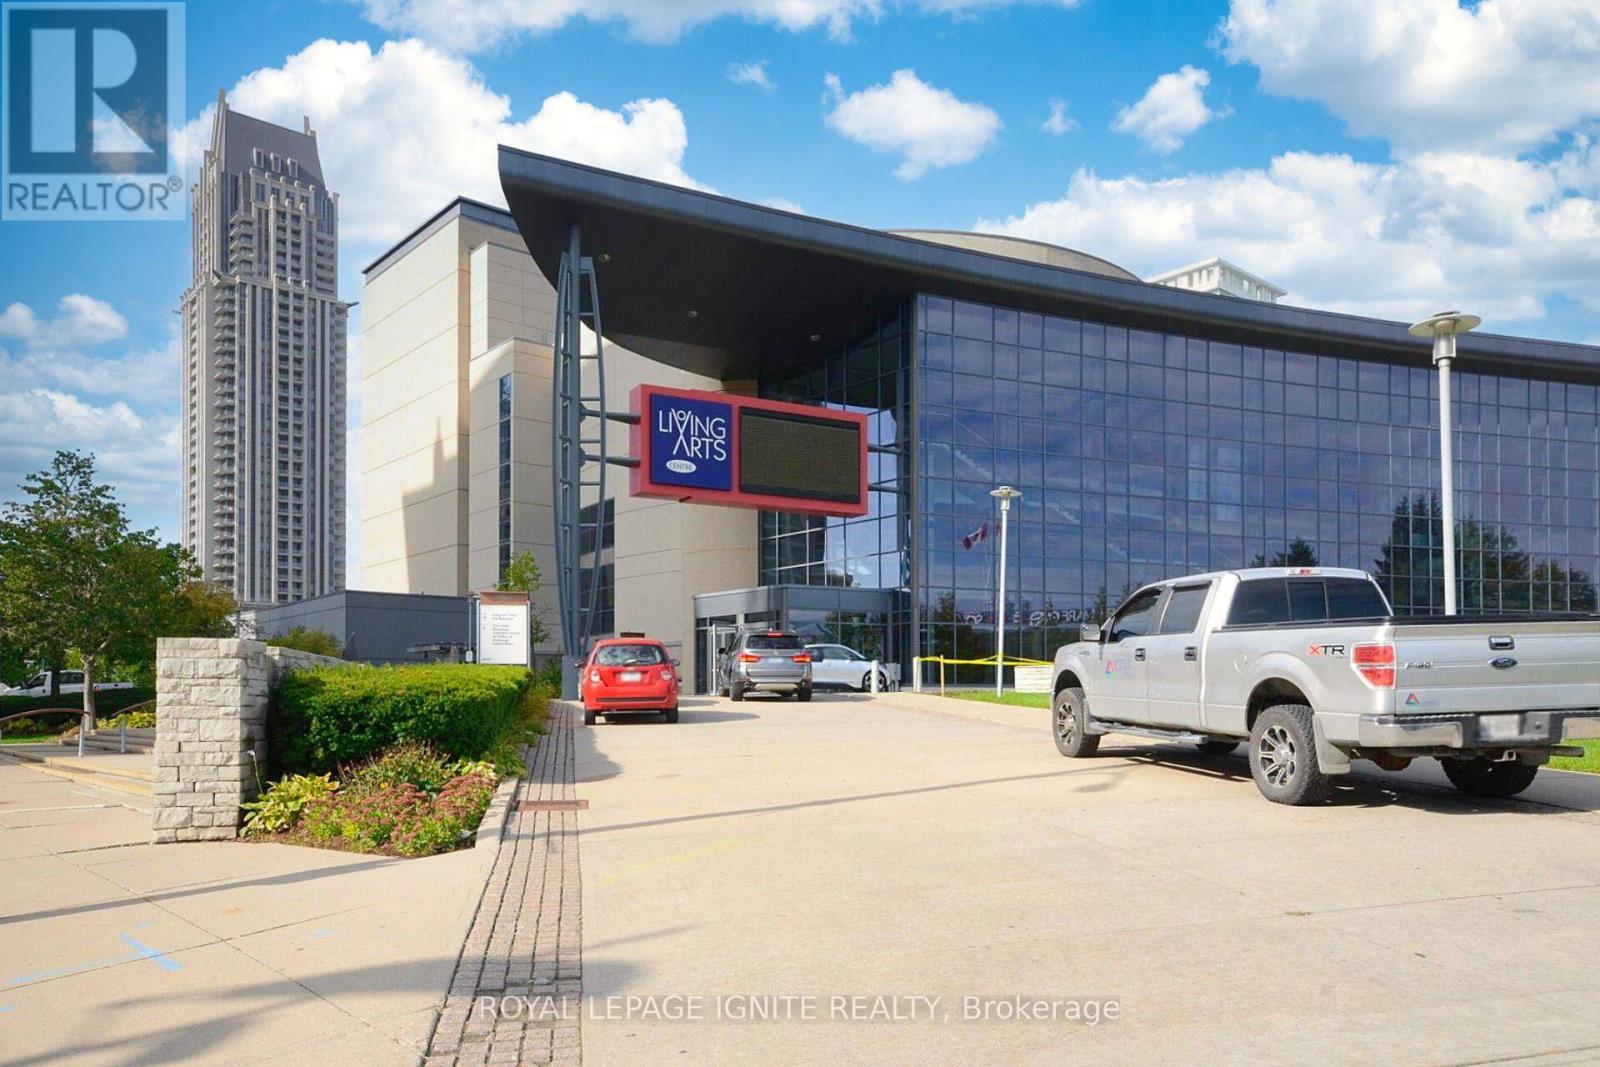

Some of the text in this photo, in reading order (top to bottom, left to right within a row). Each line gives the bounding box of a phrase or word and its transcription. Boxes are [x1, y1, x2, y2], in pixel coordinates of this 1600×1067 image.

[659, 407, 727, 440] LIVING
[672, 436, 727, 462] ARTS
[668, 461, 693, 471] CENTRE
[1309, 644, 1345, 655] XTR
